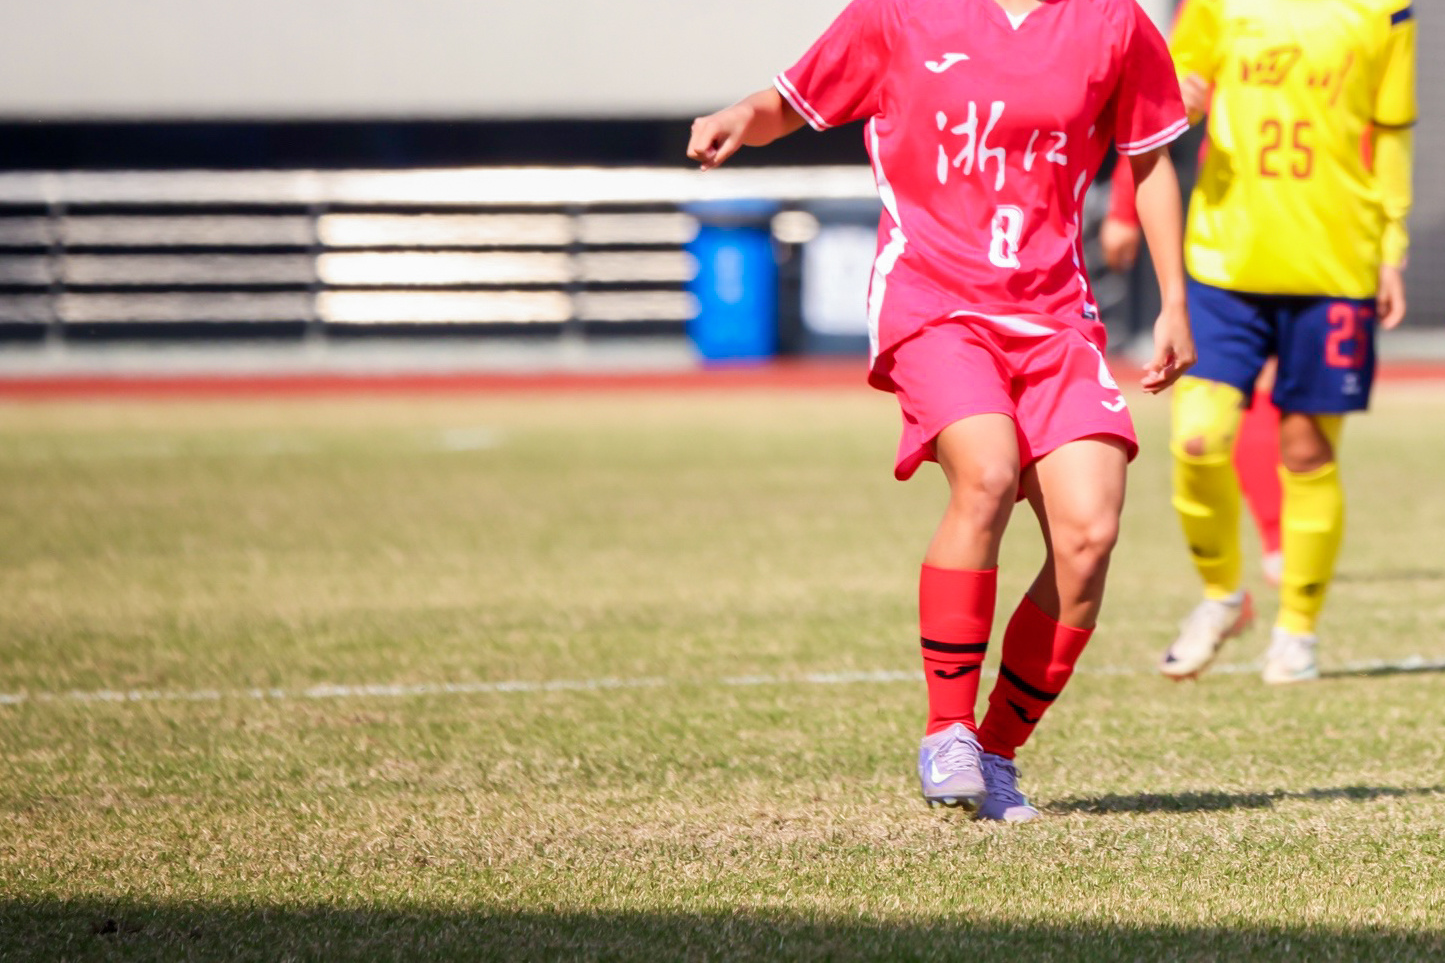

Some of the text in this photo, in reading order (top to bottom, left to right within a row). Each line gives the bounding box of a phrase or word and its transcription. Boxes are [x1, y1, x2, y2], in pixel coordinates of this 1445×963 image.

[936, 100, 1068, 192] 浙江
[1260, 118, 1315, 178] 25
[988, 205, 1024, 269] 8
